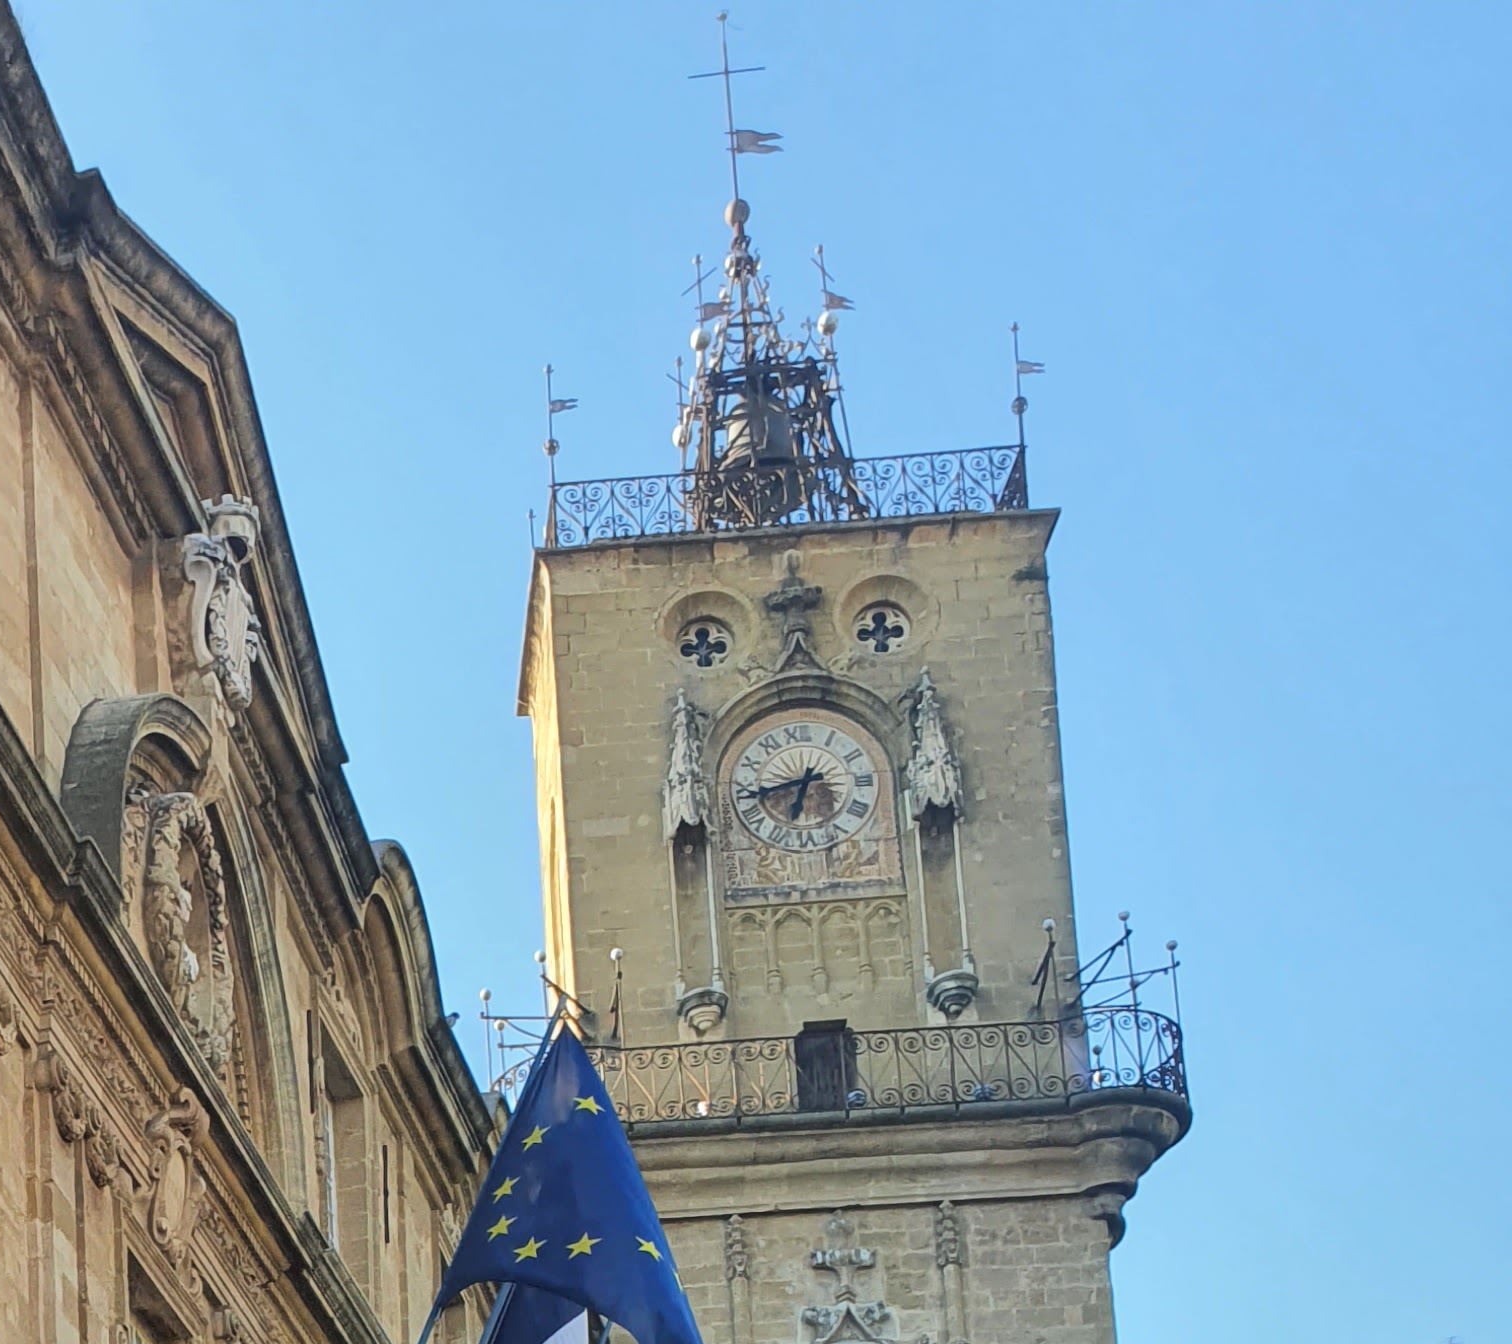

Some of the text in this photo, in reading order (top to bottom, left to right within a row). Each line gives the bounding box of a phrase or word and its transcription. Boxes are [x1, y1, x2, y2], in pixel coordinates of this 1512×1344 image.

[758, 734, 783, 756] XI
[741, 755, 761, 773] X
[843, 748, 864, 764] II
